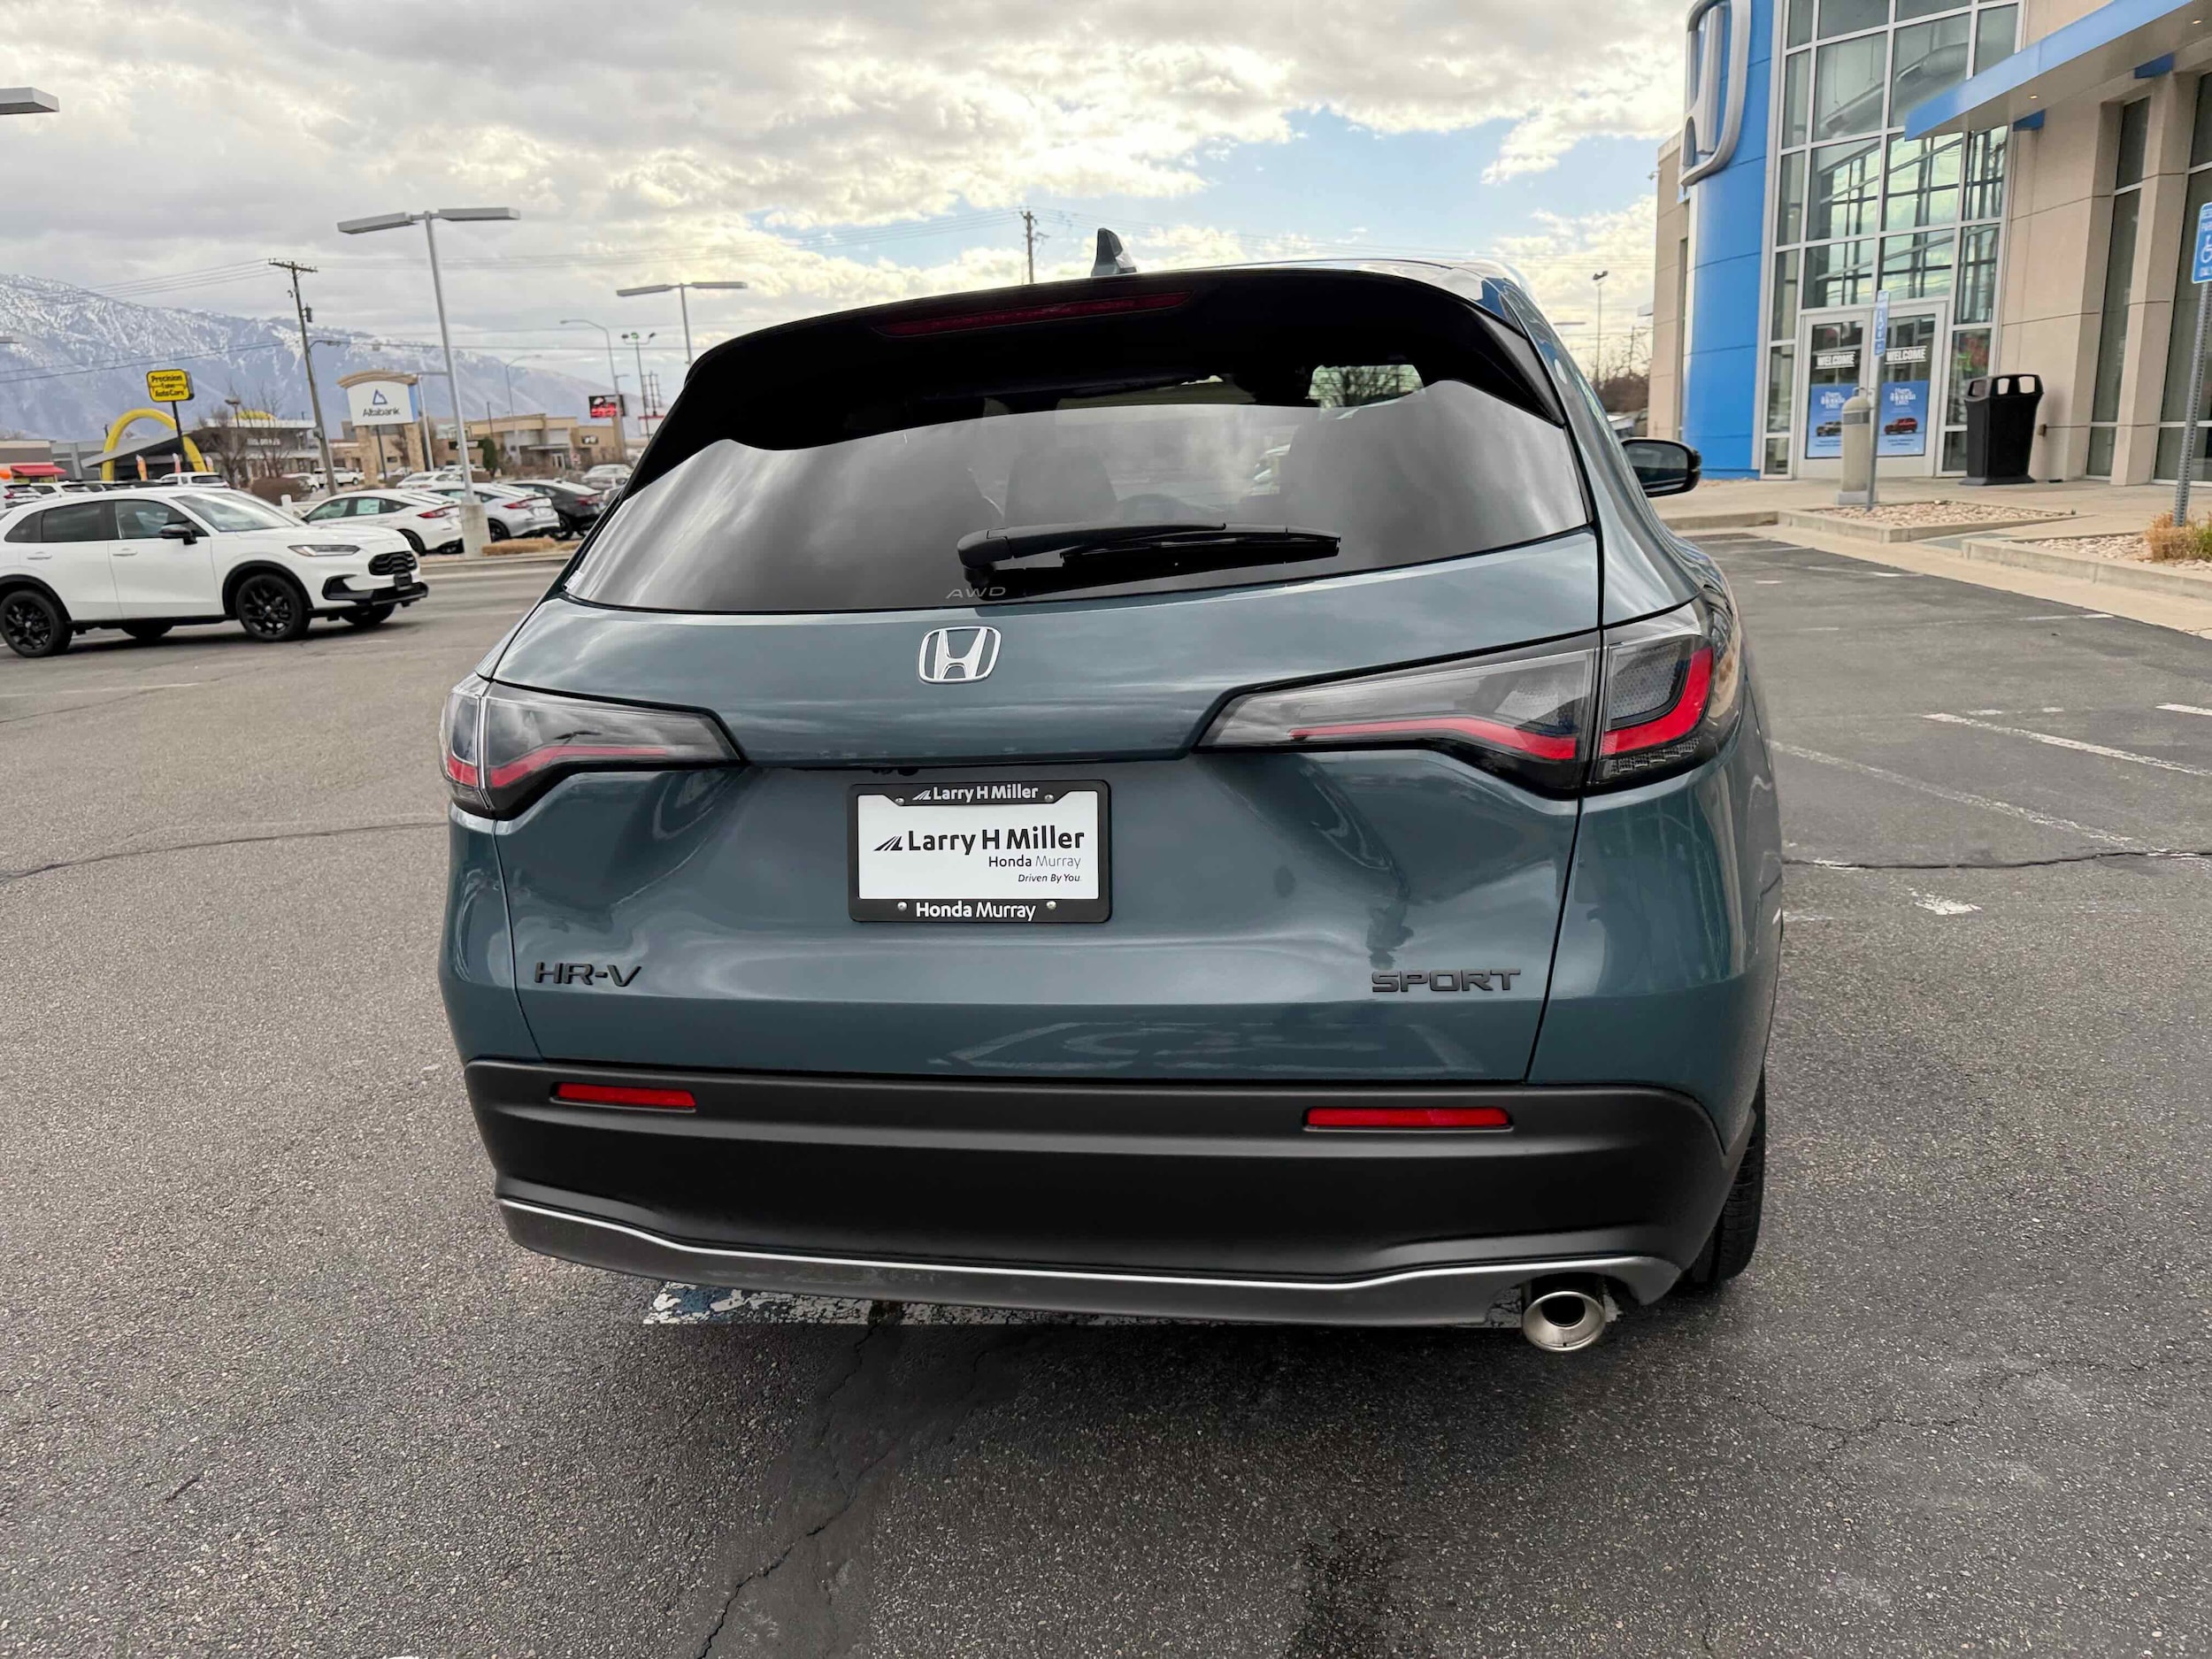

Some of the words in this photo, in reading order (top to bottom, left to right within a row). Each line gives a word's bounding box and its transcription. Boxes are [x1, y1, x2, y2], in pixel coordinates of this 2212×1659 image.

[1886, 348, 1926, 362] WELCOME
[945, 587, 1006, 599] AWD
[933, 787, 974, 803] Larry
[976, 785, 988, 800] H
[991, 783, 1039, 799] Miller
[908, 830, 977, 856] Larry
[981, 829, 1000, 849] H
[1006, 825, 1085, 849] Miller
[988, 854, 1032, 867] Honda
[1035, 855, 1081, 869] Murray
[1018, 873, 1048, 882] Driven
[1050, 873, 1062, 884] By
[916, 900, 972, 918] Honda
[975, 902, 1036, 922] Murray
[534, 961, 642, 987] HR-V
[1371, 968, 1522, 993] SPORT
